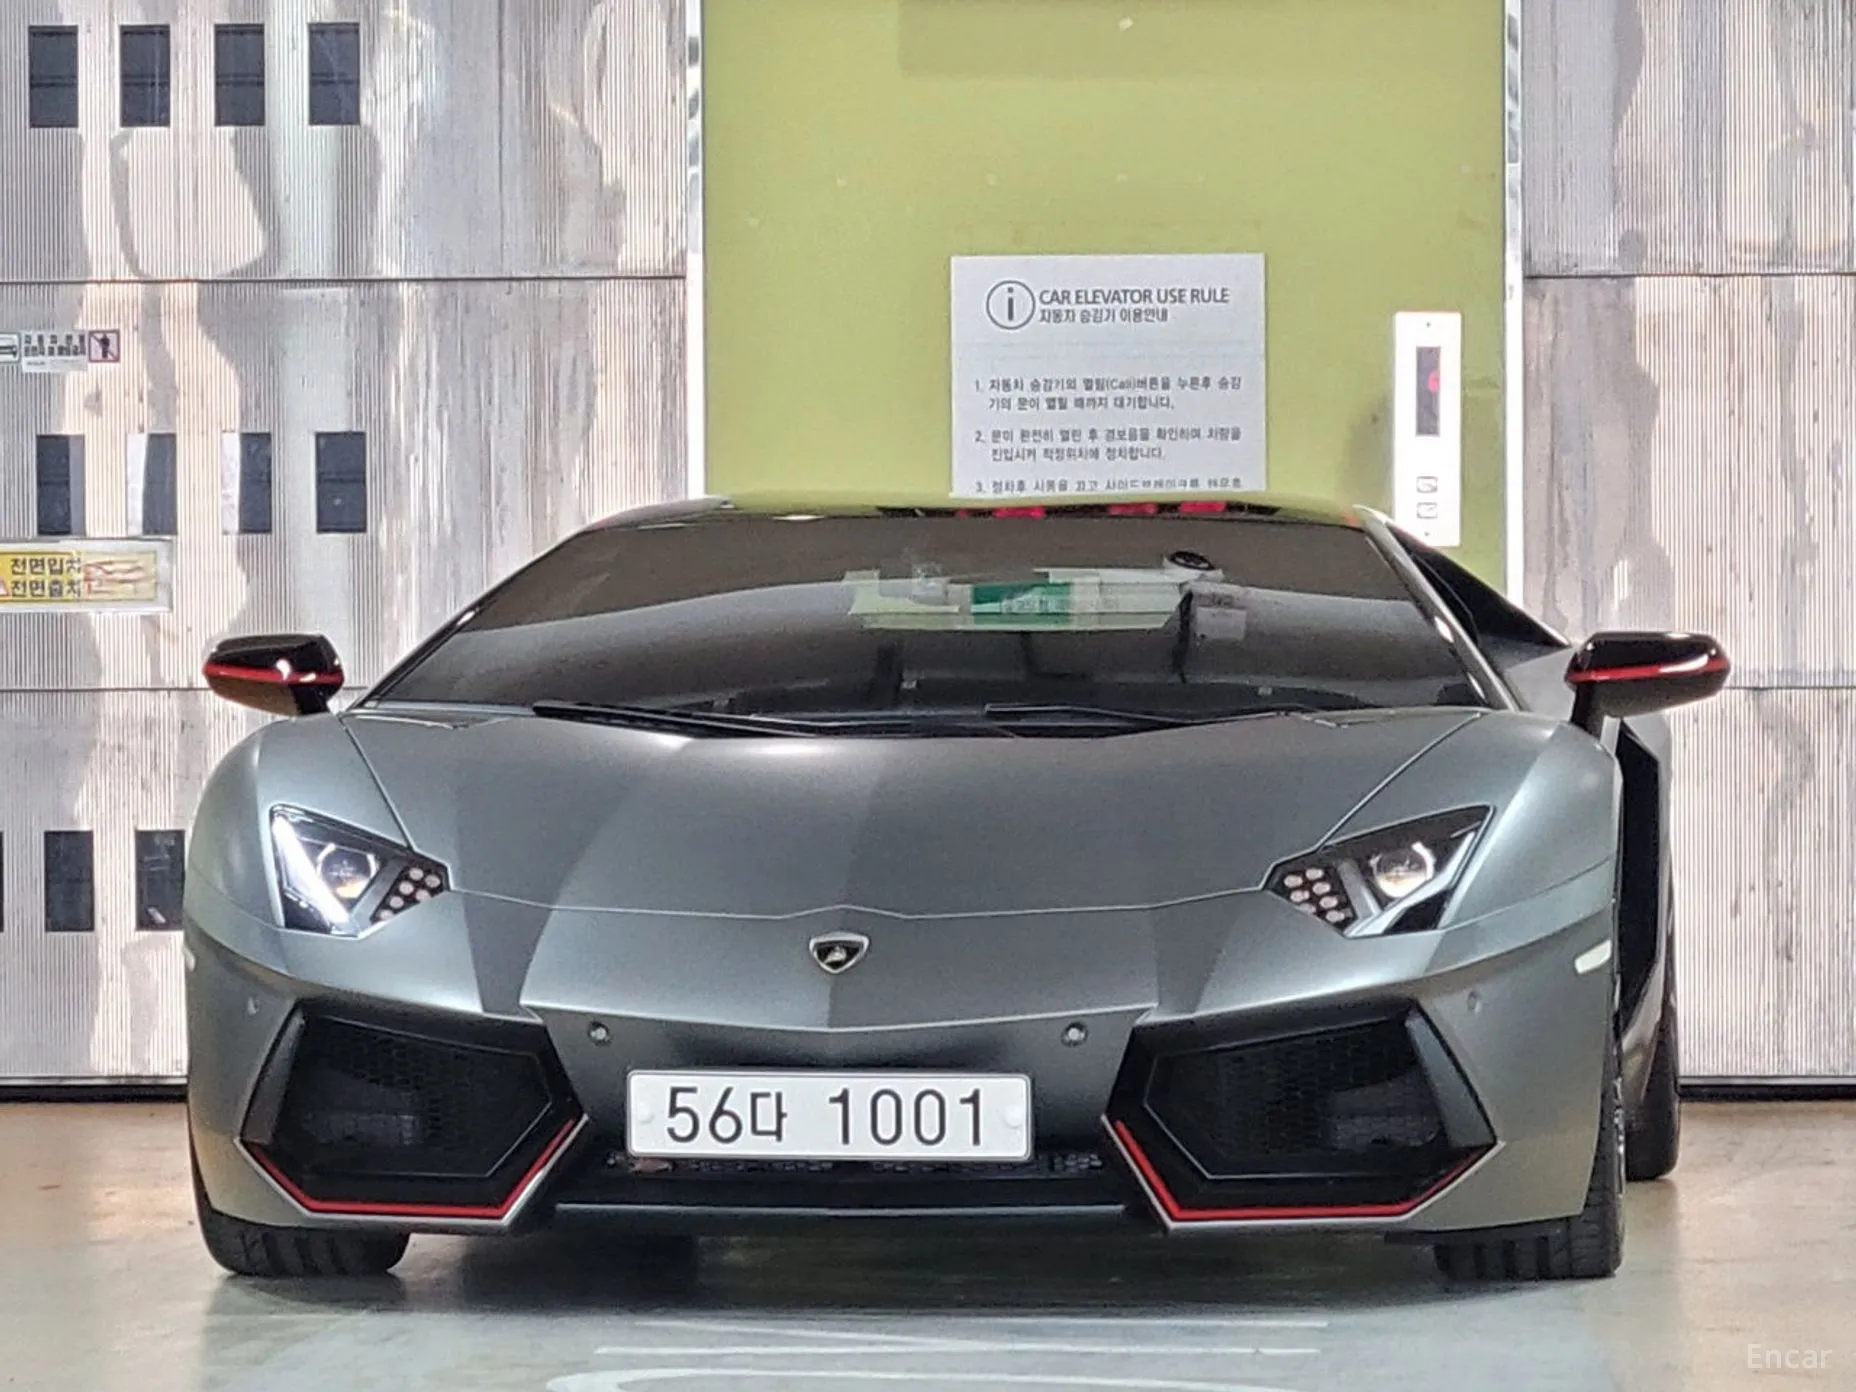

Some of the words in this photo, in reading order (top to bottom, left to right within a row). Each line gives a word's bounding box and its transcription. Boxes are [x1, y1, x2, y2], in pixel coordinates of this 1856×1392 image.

[1039, 289, 1072, 305] CAR
[1074, 288, 1153, 305] ELEVATOR
[1156, 287, 1188, 305] USE
[1189, 287, 1231, 304] RULE
[1038, 308, 1077, 324] 자동차
[1080, 308, 1117, 324] 승강기
[1119, 307, 1169, 323] 이용안내
[988, 378, 1025, 393] 자동차
[1029, 378, 1077, 393] 승강기의
[1217, 376, 1242, 391] 승강
[989, 397, 1012, 411] 기의
[1017, 397, 1040, 411] 문이
[1073, 396, 1109, 410] 때까지
[1113, 395, 1175, 410] 대기합니다.
[1020, 428, 1054, 443] 완전히
[1156, 426, 1201, 441] 확인하여
[666, 1086, 788, 1145] 56다
[828, 1087, 981, 1147] 1001
